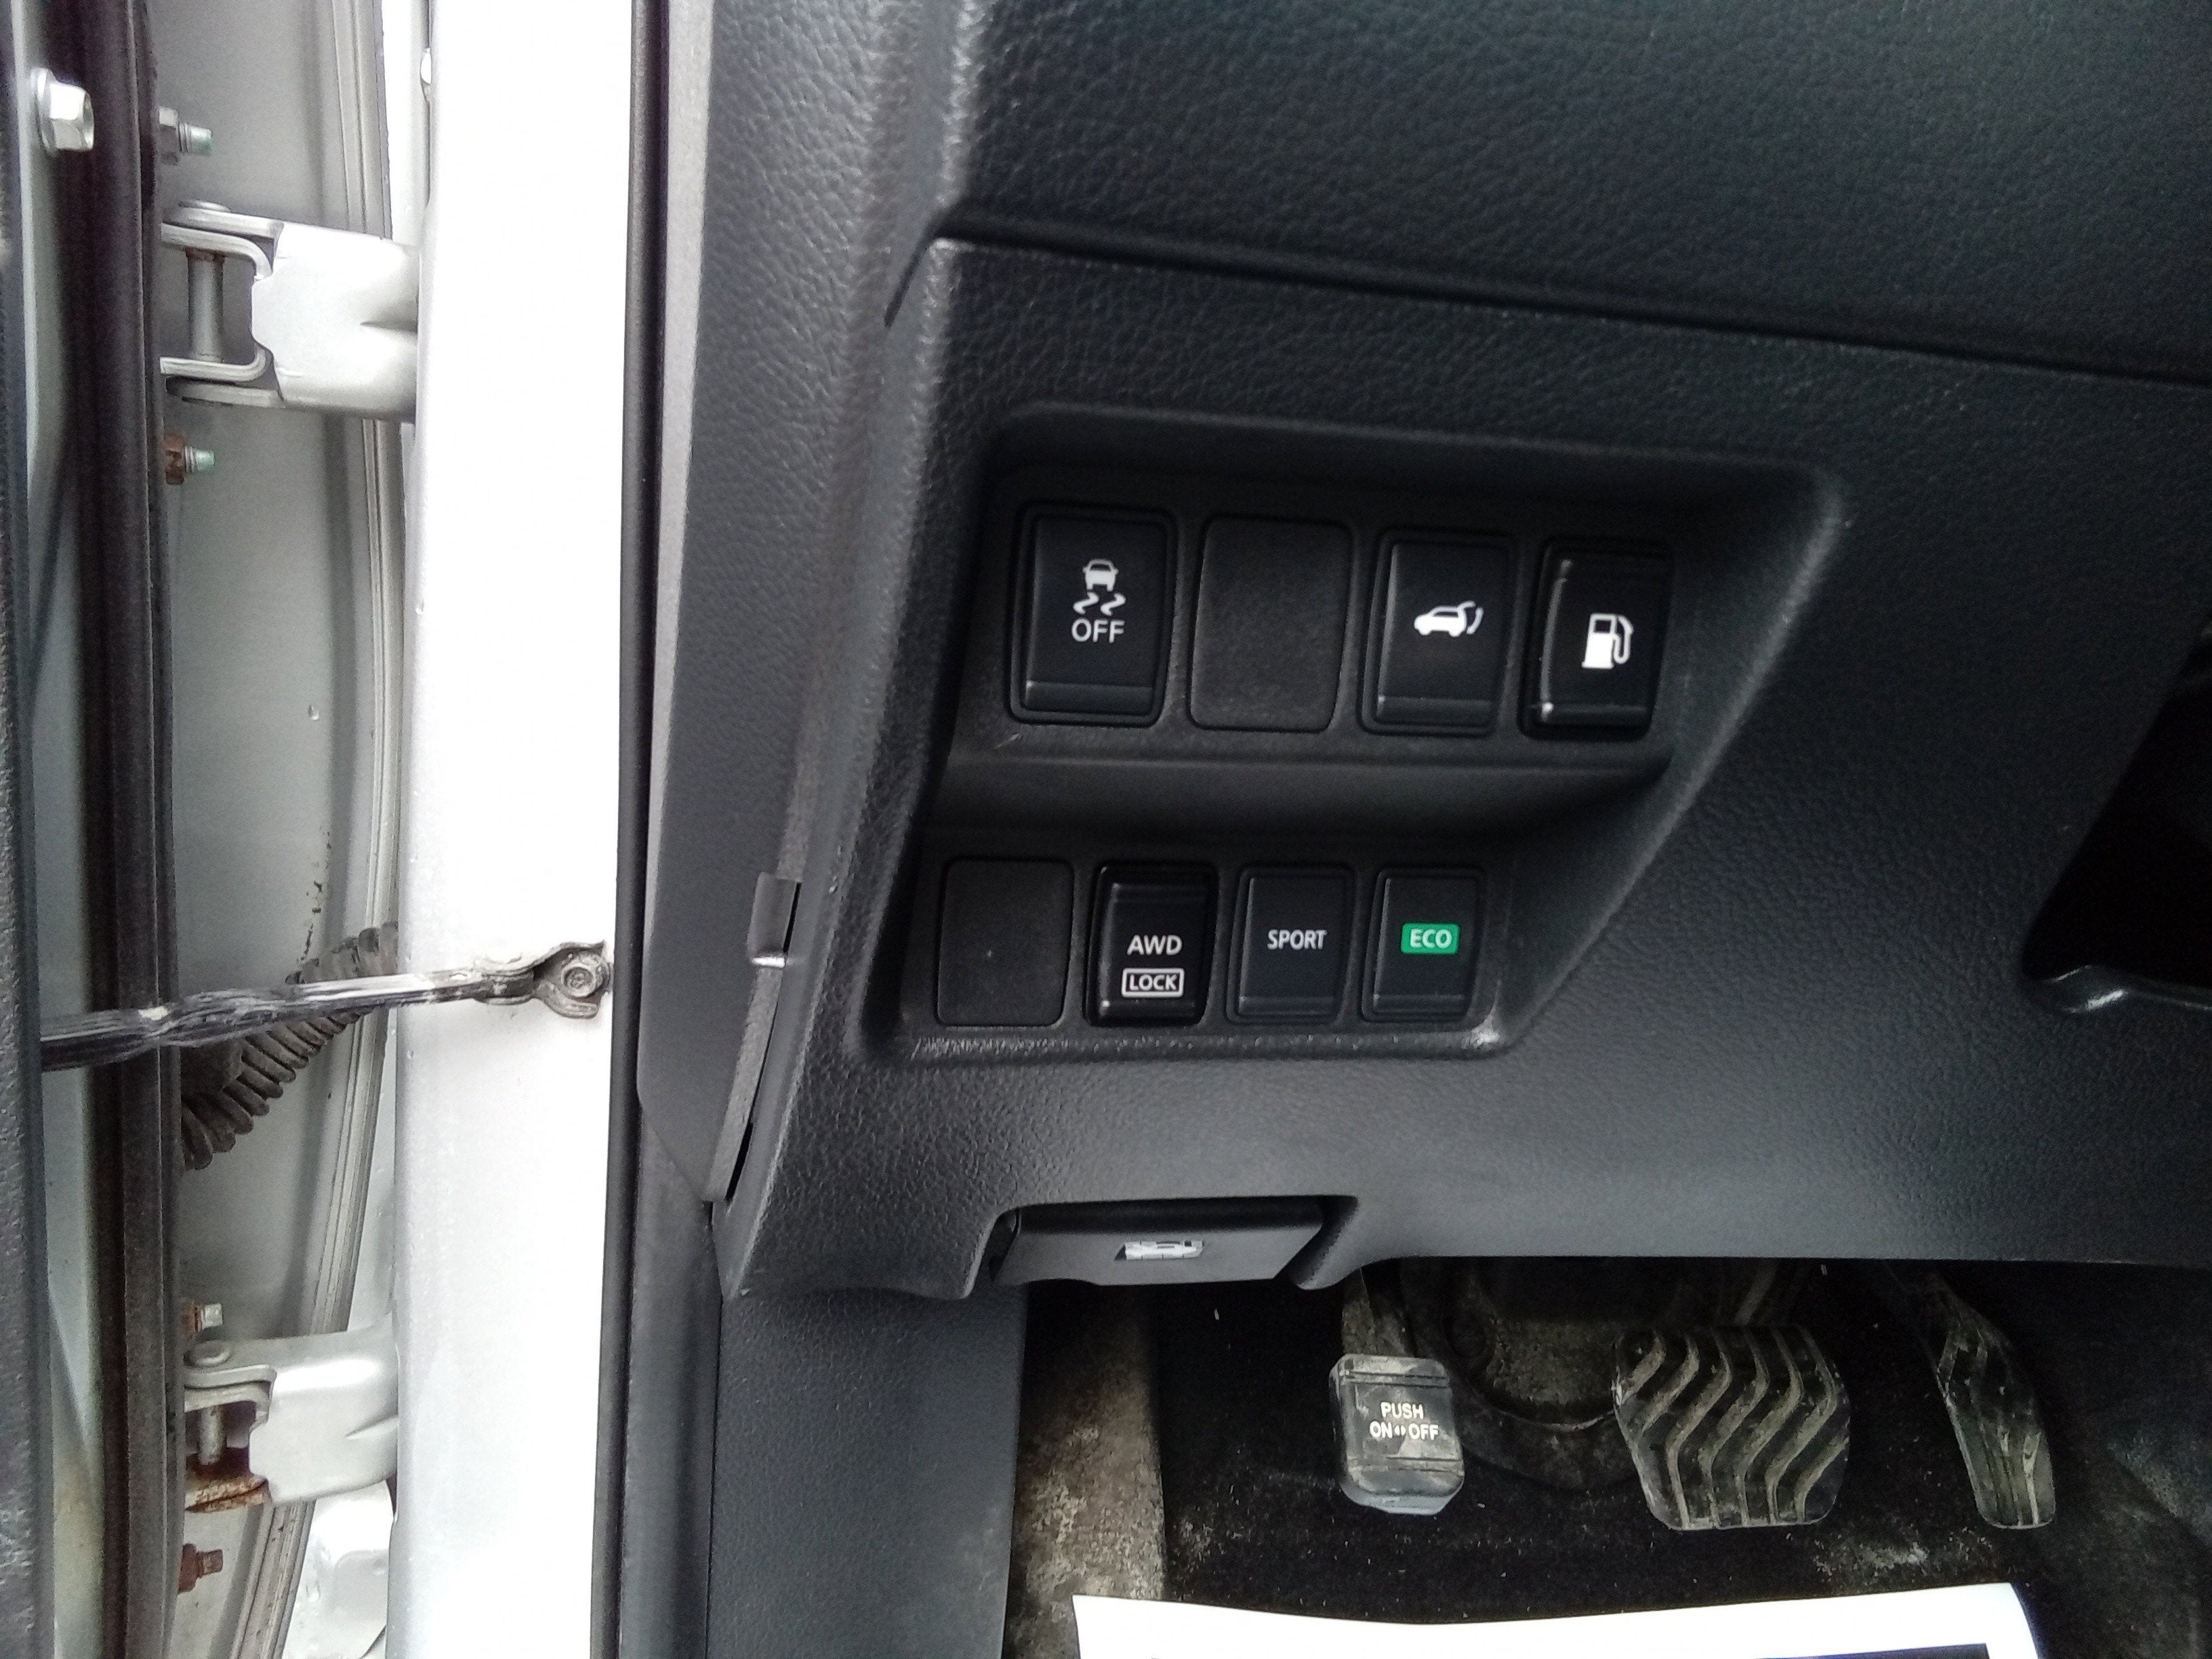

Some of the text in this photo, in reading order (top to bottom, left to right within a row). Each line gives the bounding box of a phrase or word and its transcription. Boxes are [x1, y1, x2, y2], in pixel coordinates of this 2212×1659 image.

[1071, 618, 1124, 642] OFF
[1127, 935, 1183, 955] AWD
[1267, 929, 1326, 949] SPORT
[1410, 929, 1452, 947] ECO
[1128, 976, 1178, 991] LOCK
[1380, 1401, 1425, 1420] PUSH
[1370, 1420, 1439, 1441] ON OFF
